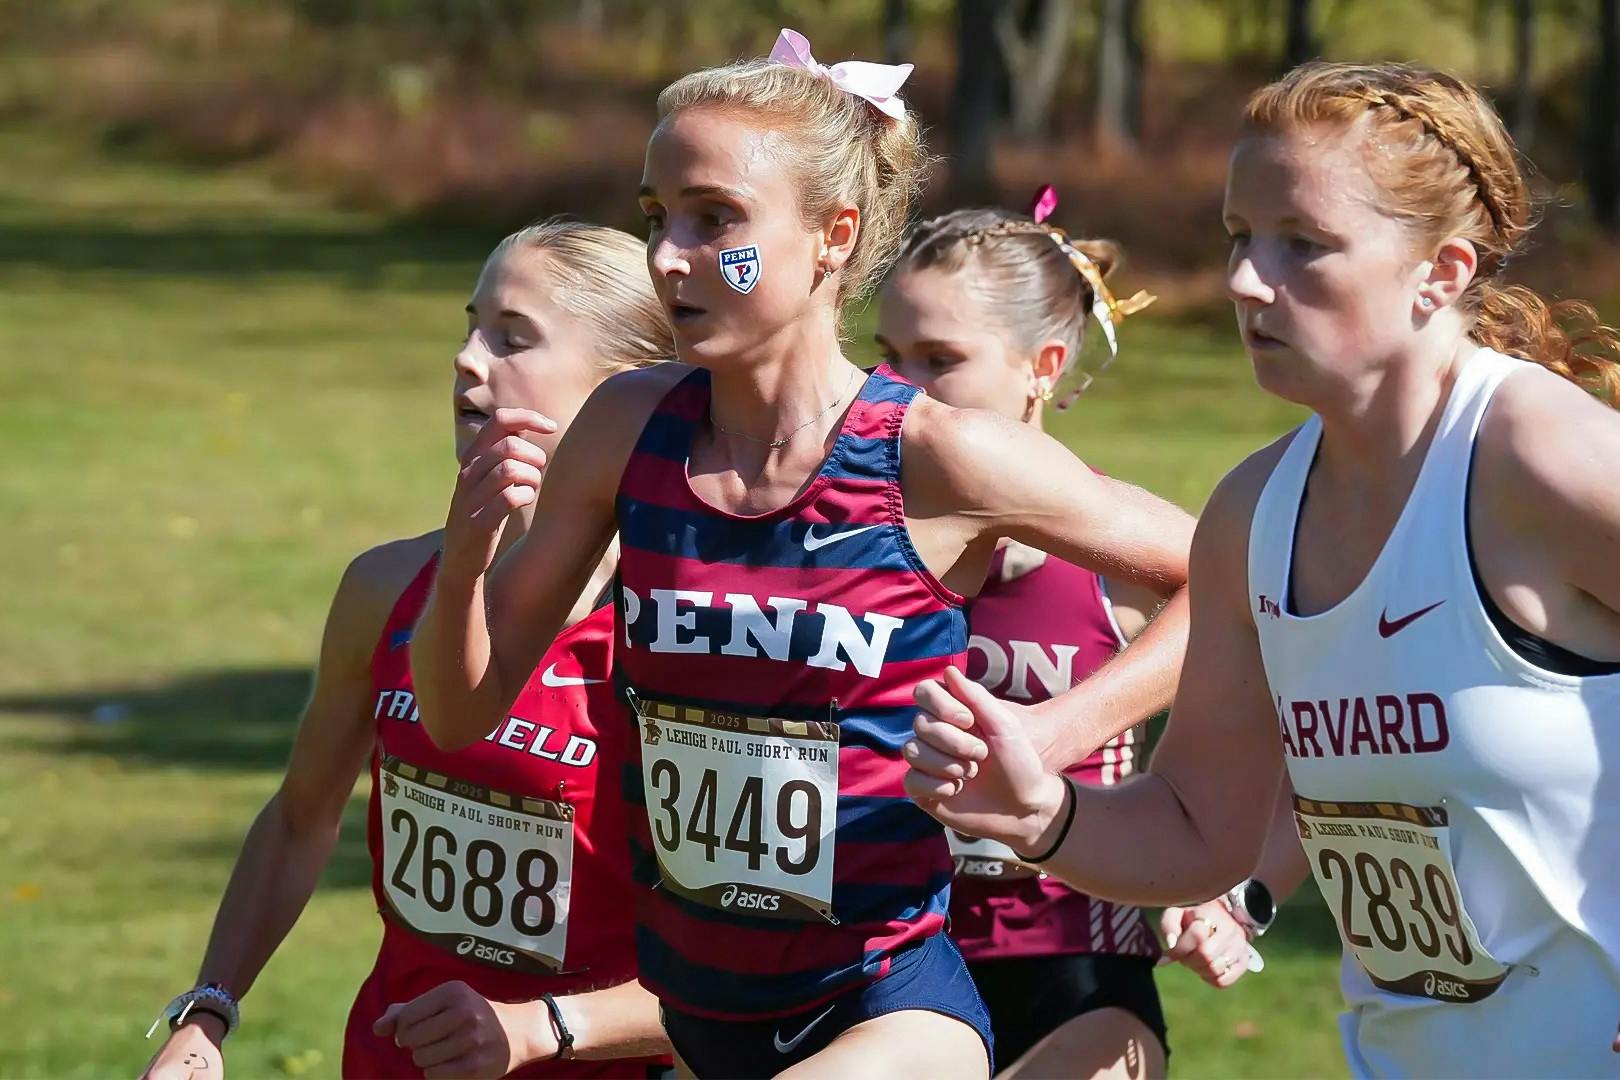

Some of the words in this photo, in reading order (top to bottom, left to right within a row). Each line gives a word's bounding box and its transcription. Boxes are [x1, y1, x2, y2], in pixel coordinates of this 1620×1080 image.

[723, 249, 755, 262] PENN
[623, 585, 905, 679] PENN
[666, 727, 707, 750] LEHIGH
[711, 736, 742, 755] PAUL
[746, 742, 793, 761] SHORT
[798, 747, 829, 763] RUN
[710, 713, 741, 728] 2025
[1277, 692, 1450, 758] ARVARD
[404, 784, 446, 813] LEHIGH
[450, 801, 484, 824] PAUL
[487, 814, 531, 833] SHORT
[535, 823, 564, 840] RUN
[651, 758, 822, 875] 3449
[1312, 822, 1357, 837] LEHIGH
[1357, 824, 1388, 839] PAUL
[391, 808, 559, 937] 2688
[1318, 848, 1474, 966] 2839
